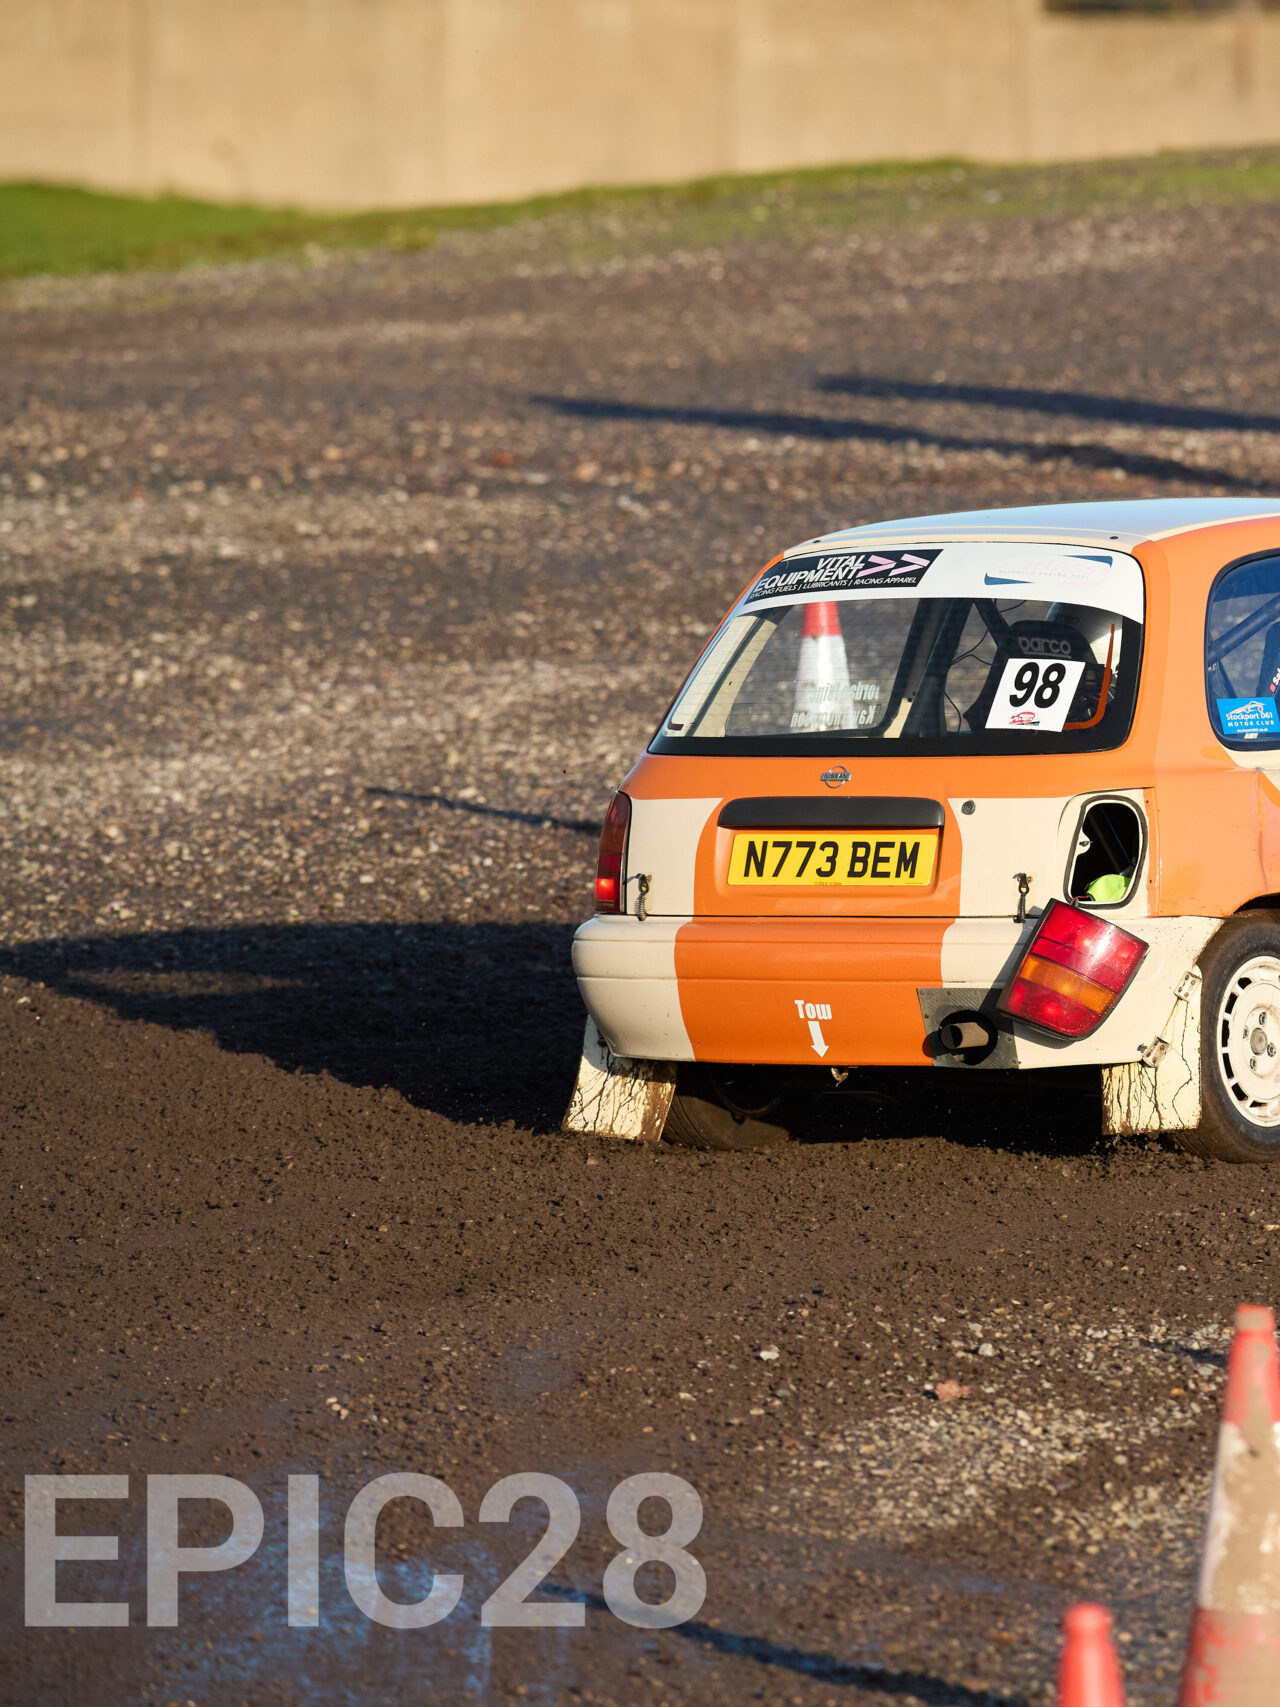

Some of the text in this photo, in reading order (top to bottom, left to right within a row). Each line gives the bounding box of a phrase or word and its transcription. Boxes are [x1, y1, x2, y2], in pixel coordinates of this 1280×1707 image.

[817, 554, 866, 571] VITAL
[752, 565, 864, 594] EQUIPMENT
[775, 584, 798, 595] FUELS
[803, 579, 848, 590] LUBRICANTS
[853, 577, 884, 586] RACING
[883, 576, 918, 585] APPAREL
[1008, 661, 1067, 709] 98
[1225, 711, 1274, 722] Stockport 061
[743, 840, 920, 878] N773 BEM
[793, 999, 833, 1020] Tow
